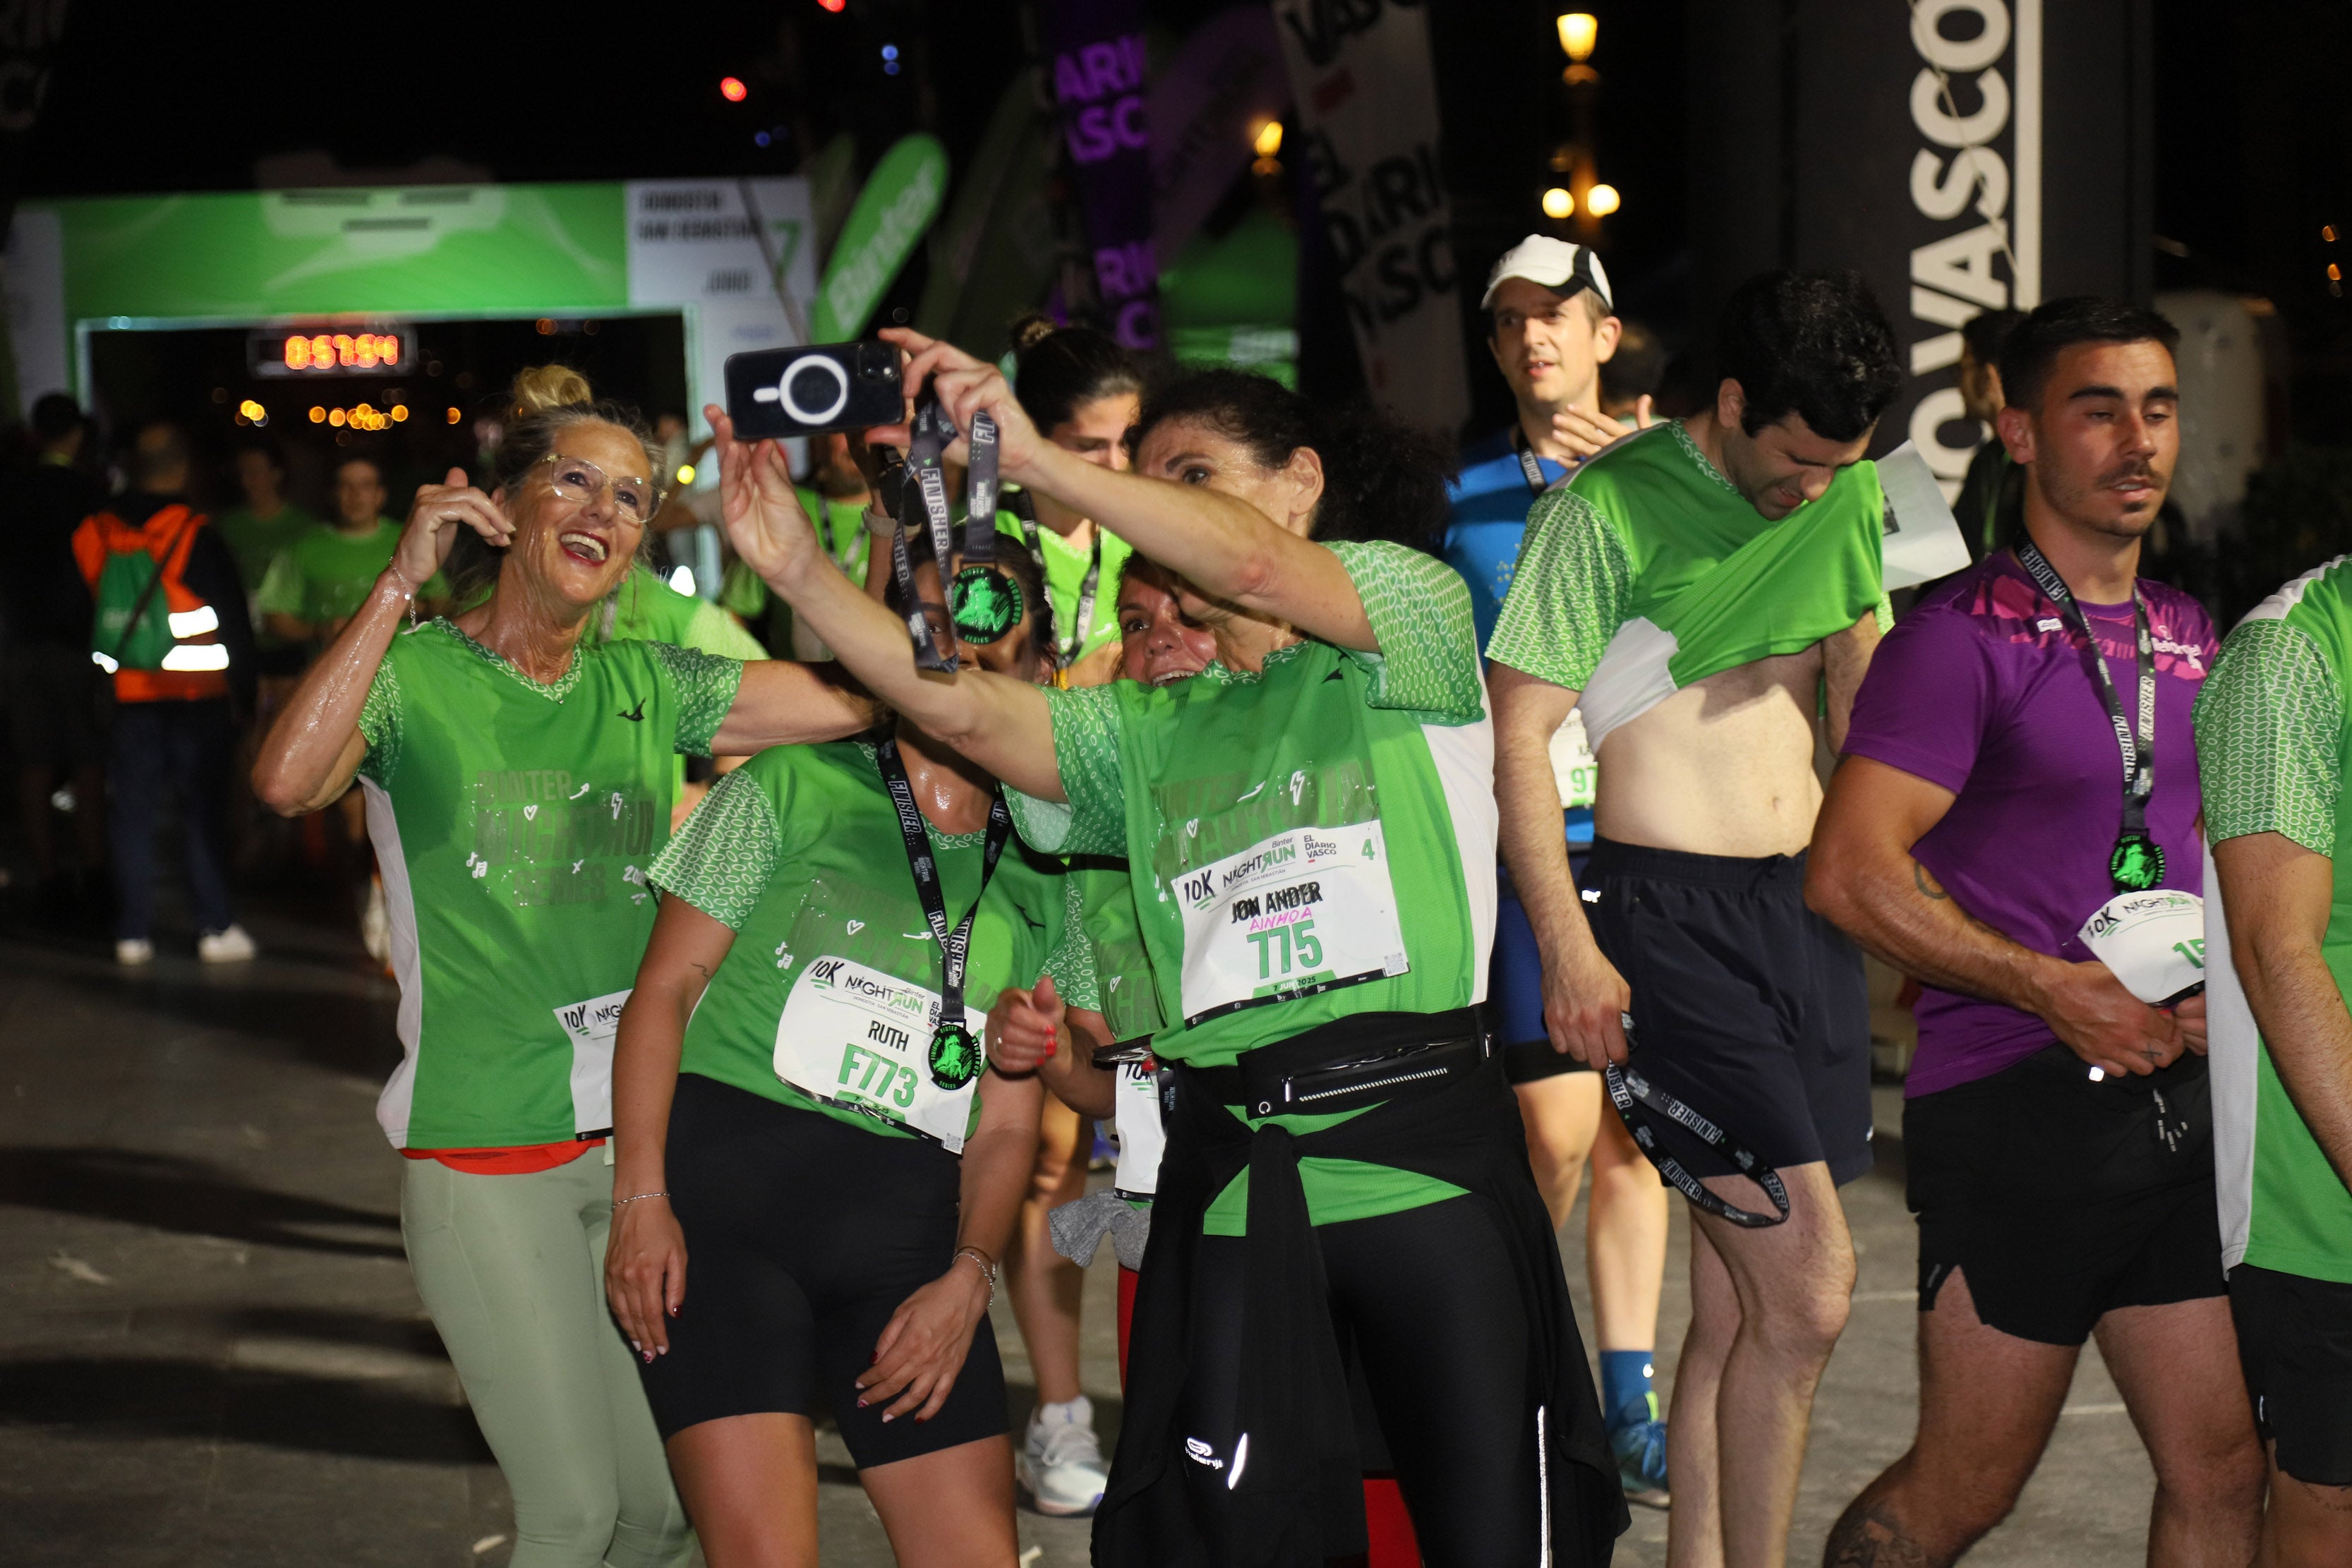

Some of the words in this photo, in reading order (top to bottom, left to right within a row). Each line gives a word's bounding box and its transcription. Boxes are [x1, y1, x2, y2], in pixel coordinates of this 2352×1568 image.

[1908, 0, 2012, 508] OVASCO
[921, 468, 950, 549] FINISHER
[888, 780, 922, 833] FINISHER
[1272, 837, 1293, 848] Binter
[1305, 843, 1337, 851] DIARIO
[1306, 849, 1337, 859] VASCO
[1361, 839, 1375, 860] 4
[1184, 869, 1216, 905] 10K
[1249, 906, 1313, 932] AINHOA
[2087, 906, 2121, 939] 10K
[1246, 919, 1323, 980] 775
[807, 960, 845, 988] 10K
[1297, 976, 1316, 986] 2025
[931, 1001, 941, 1011] EL
[867, 1020, 910, 1052] RUTH
[837, 1042, 919, 1108] F773
[1667, 1099, 1723, 1145] FINISHER
